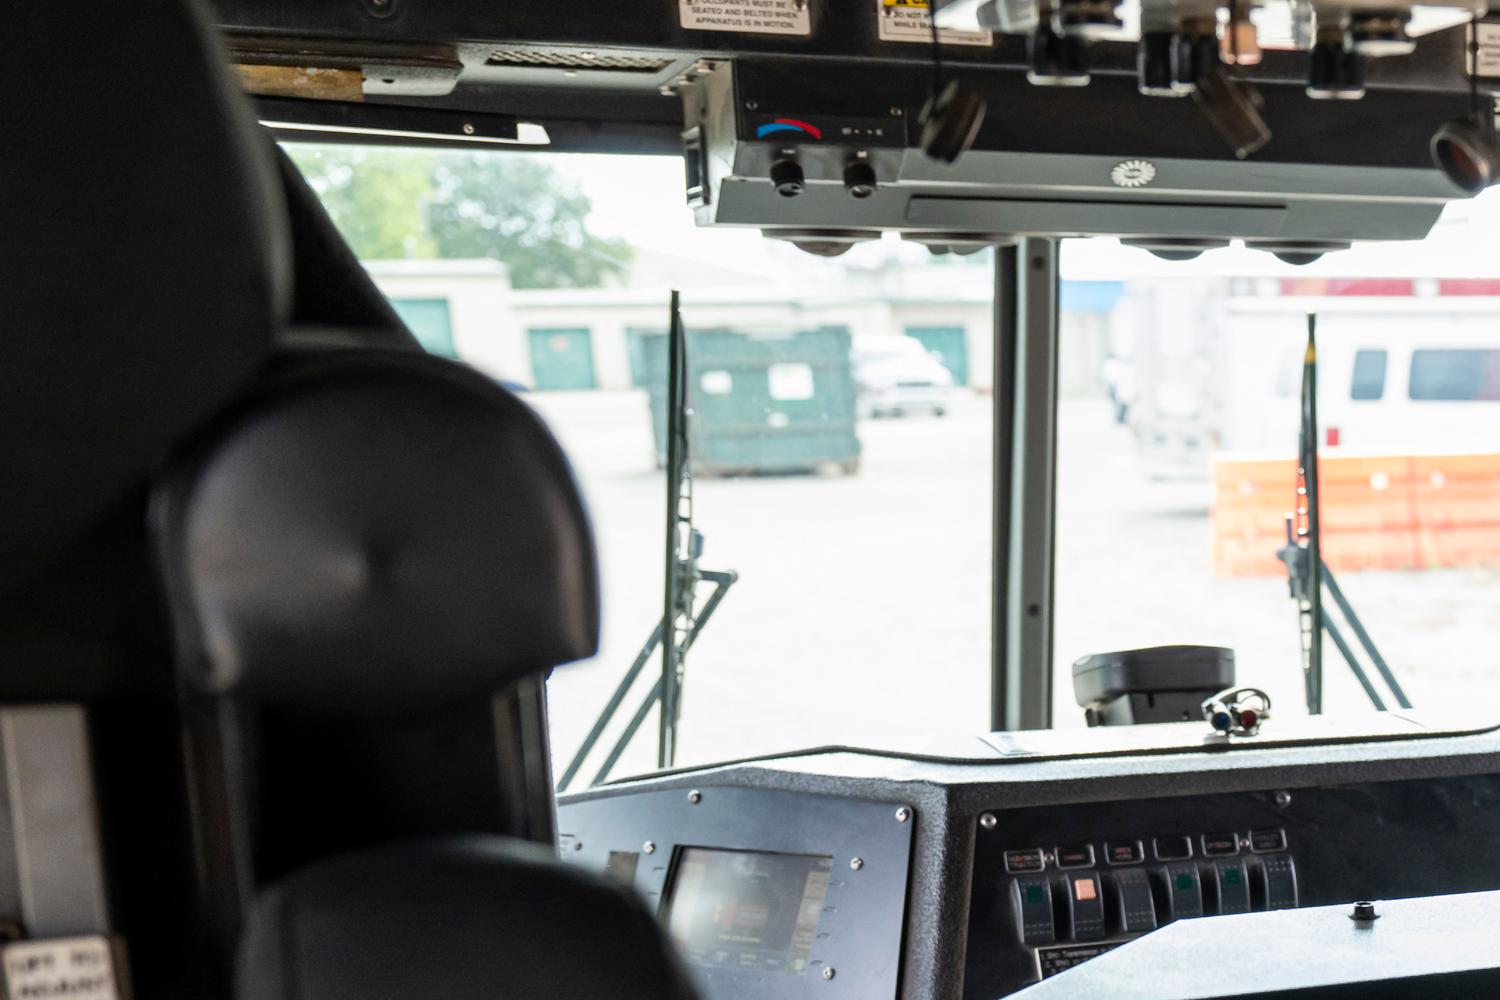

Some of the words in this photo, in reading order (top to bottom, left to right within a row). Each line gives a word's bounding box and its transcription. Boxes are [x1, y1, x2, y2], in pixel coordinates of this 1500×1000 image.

[691, 6, 723, 15] SEATED
[725, 8, 741, 16] AND
[743, 9, 774, 17] BELTED
[775, 10, 798, 19] WHEN
[696, 17, 742, 26] APPARATUS
